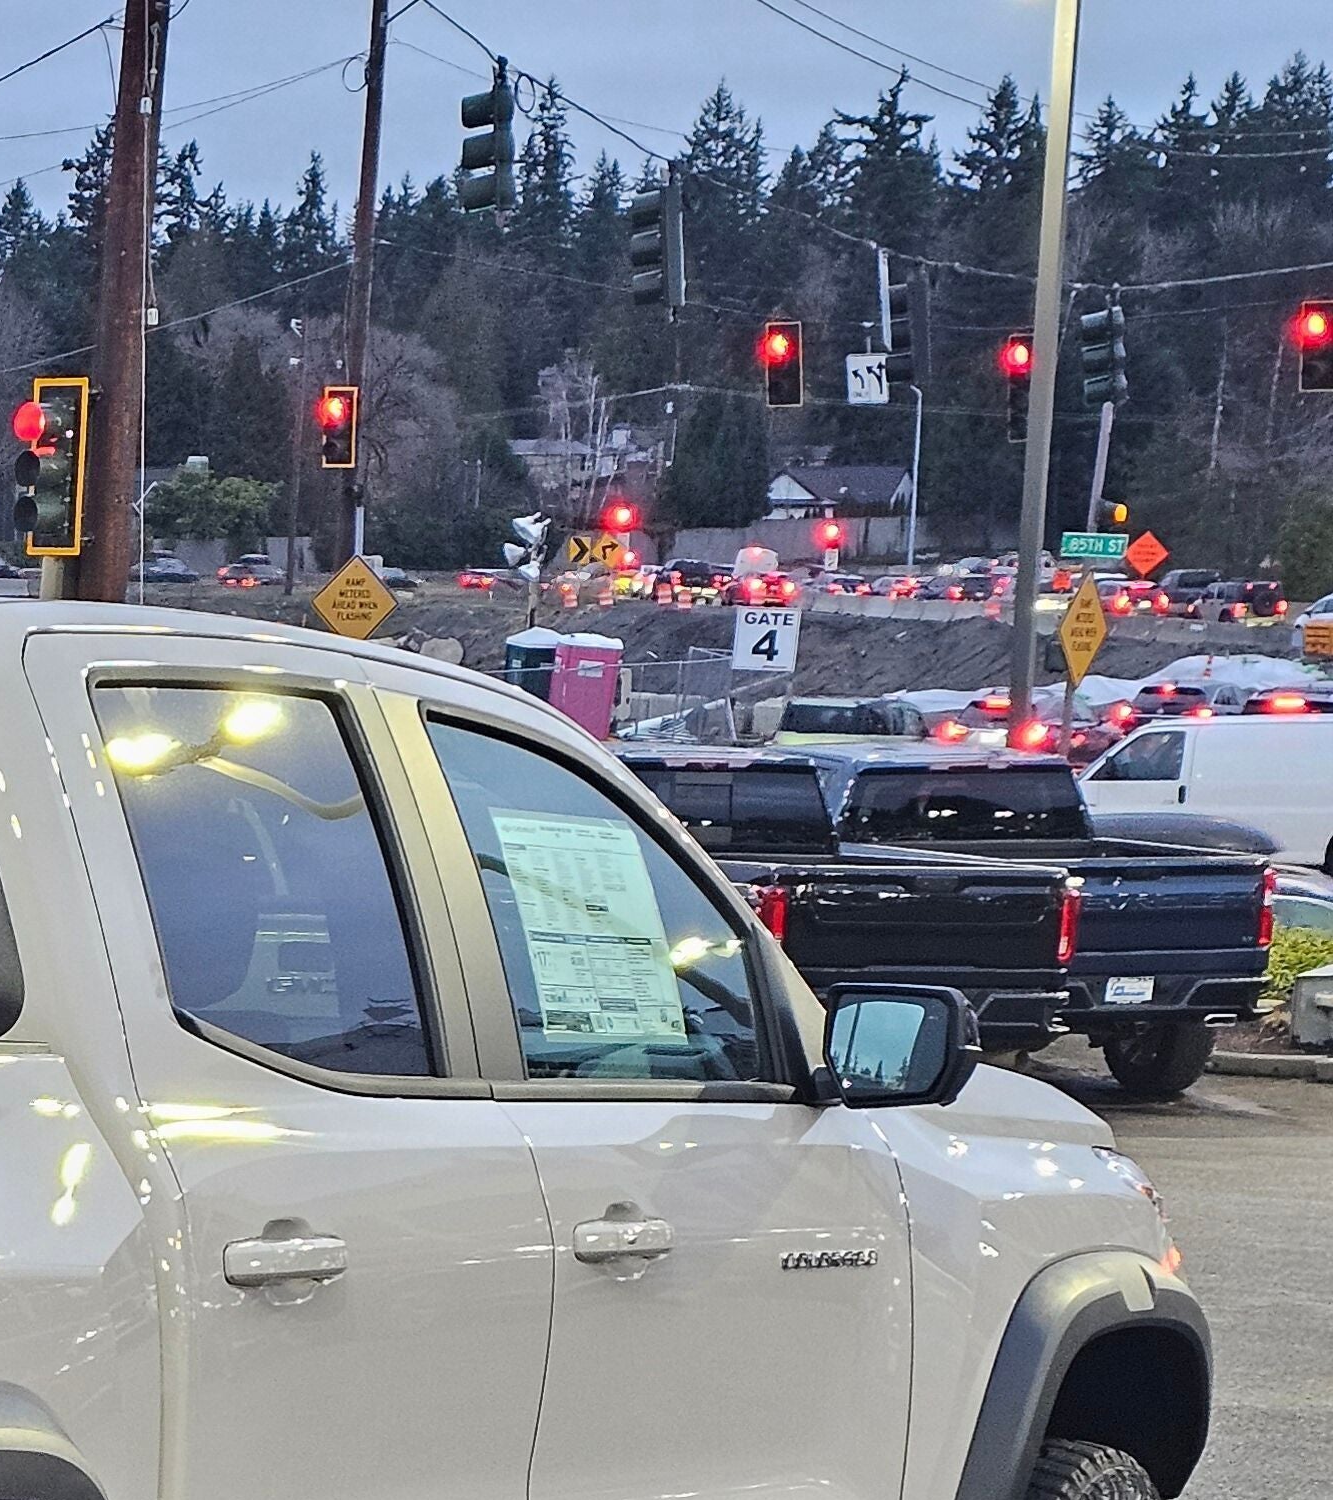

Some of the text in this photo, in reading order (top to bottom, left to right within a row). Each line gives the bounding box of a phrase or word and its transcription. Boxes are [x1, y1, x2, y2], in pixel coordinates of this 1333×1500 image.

[1068, 537, 1104, 553] 85TH
[1108, 539, 1125, 553] ST
[346, 578, 366, 586] RAMP
[332, 599, 378, 610] AHEAD WHEN
[744, 611, 794, 626] GATE
[751, 629, 779, 662] 4
